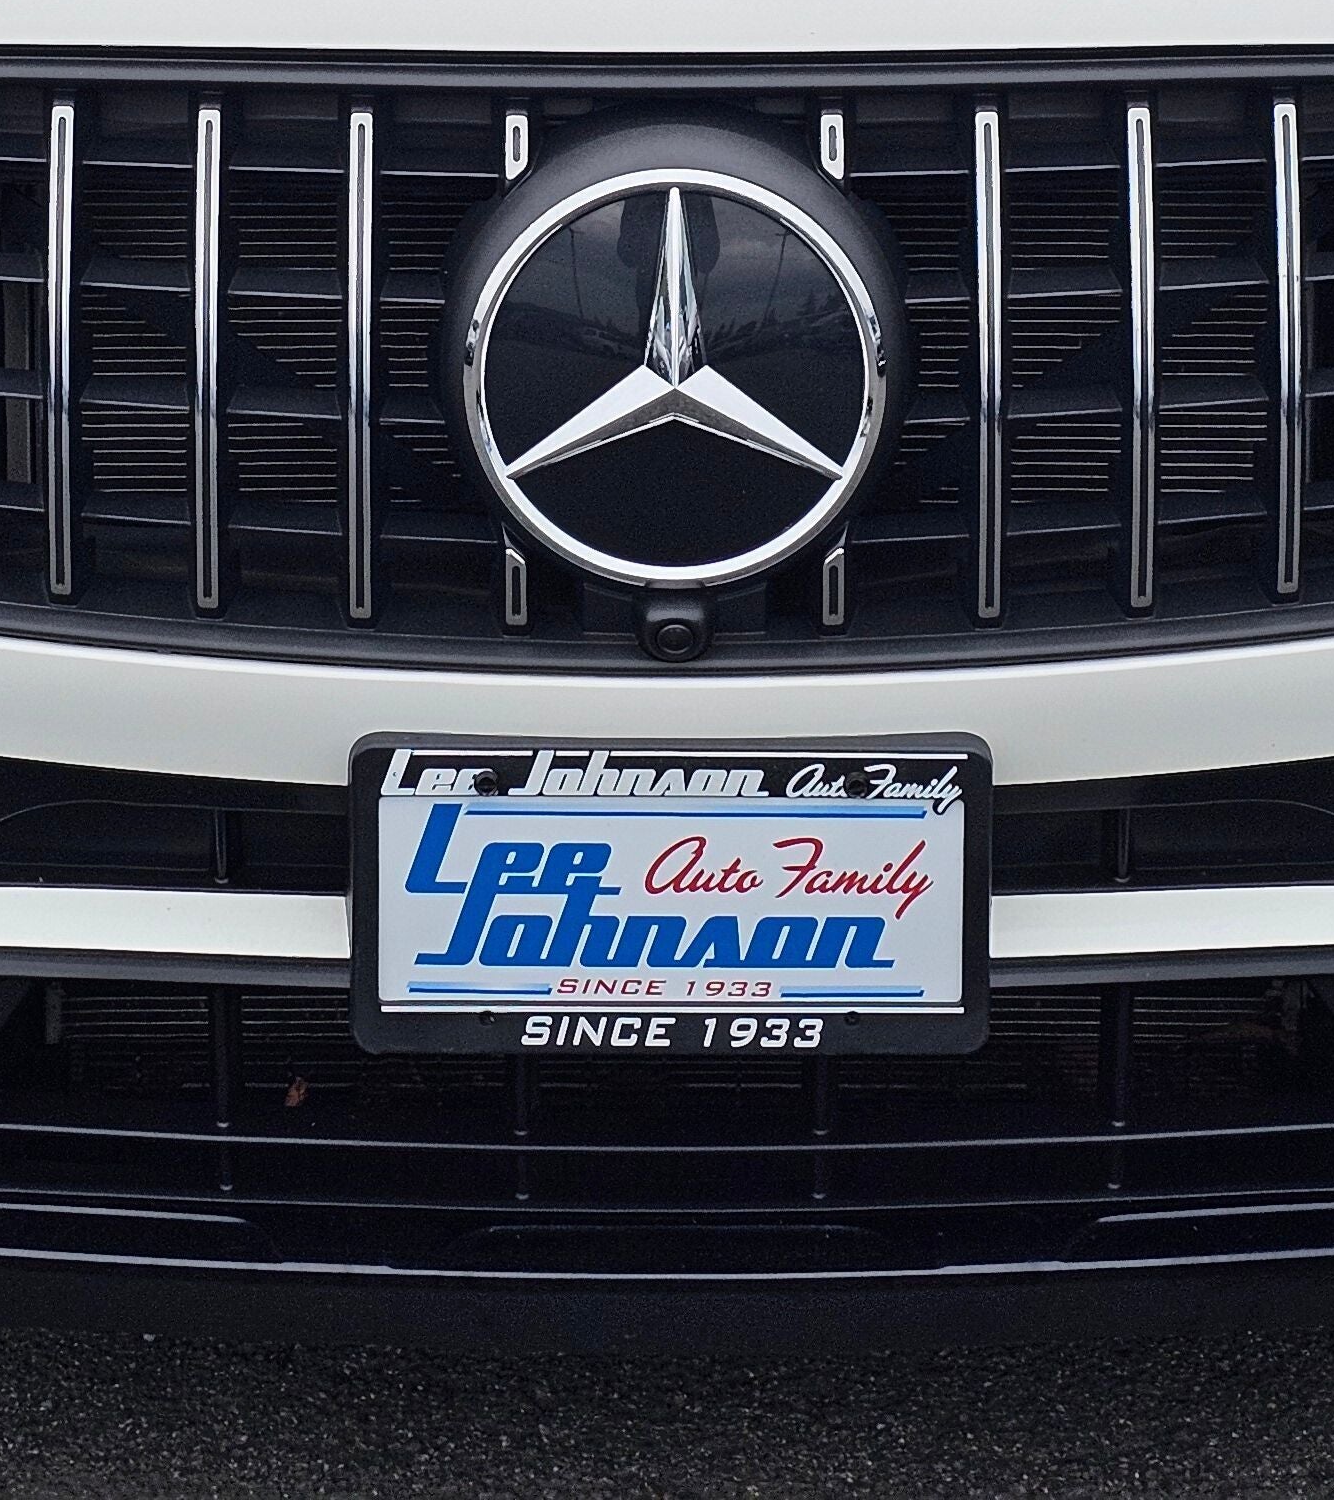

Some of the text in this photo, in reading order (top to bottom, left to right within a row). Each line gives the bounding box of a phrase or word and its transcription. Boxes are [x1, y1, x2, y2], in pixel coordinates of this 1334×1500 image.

[508, 749, 770, 797] Johnson
[785, 763, 855, 798] Aut
[863, 763, 963, 814] Family
[404, 803, 935, 920] Lee Auto Family
[414, 888, 896, 969] Johnson
[556, 977, 773, 999] SINCE 1933
[520, 1016, 824, 1049] SINCE 1933
